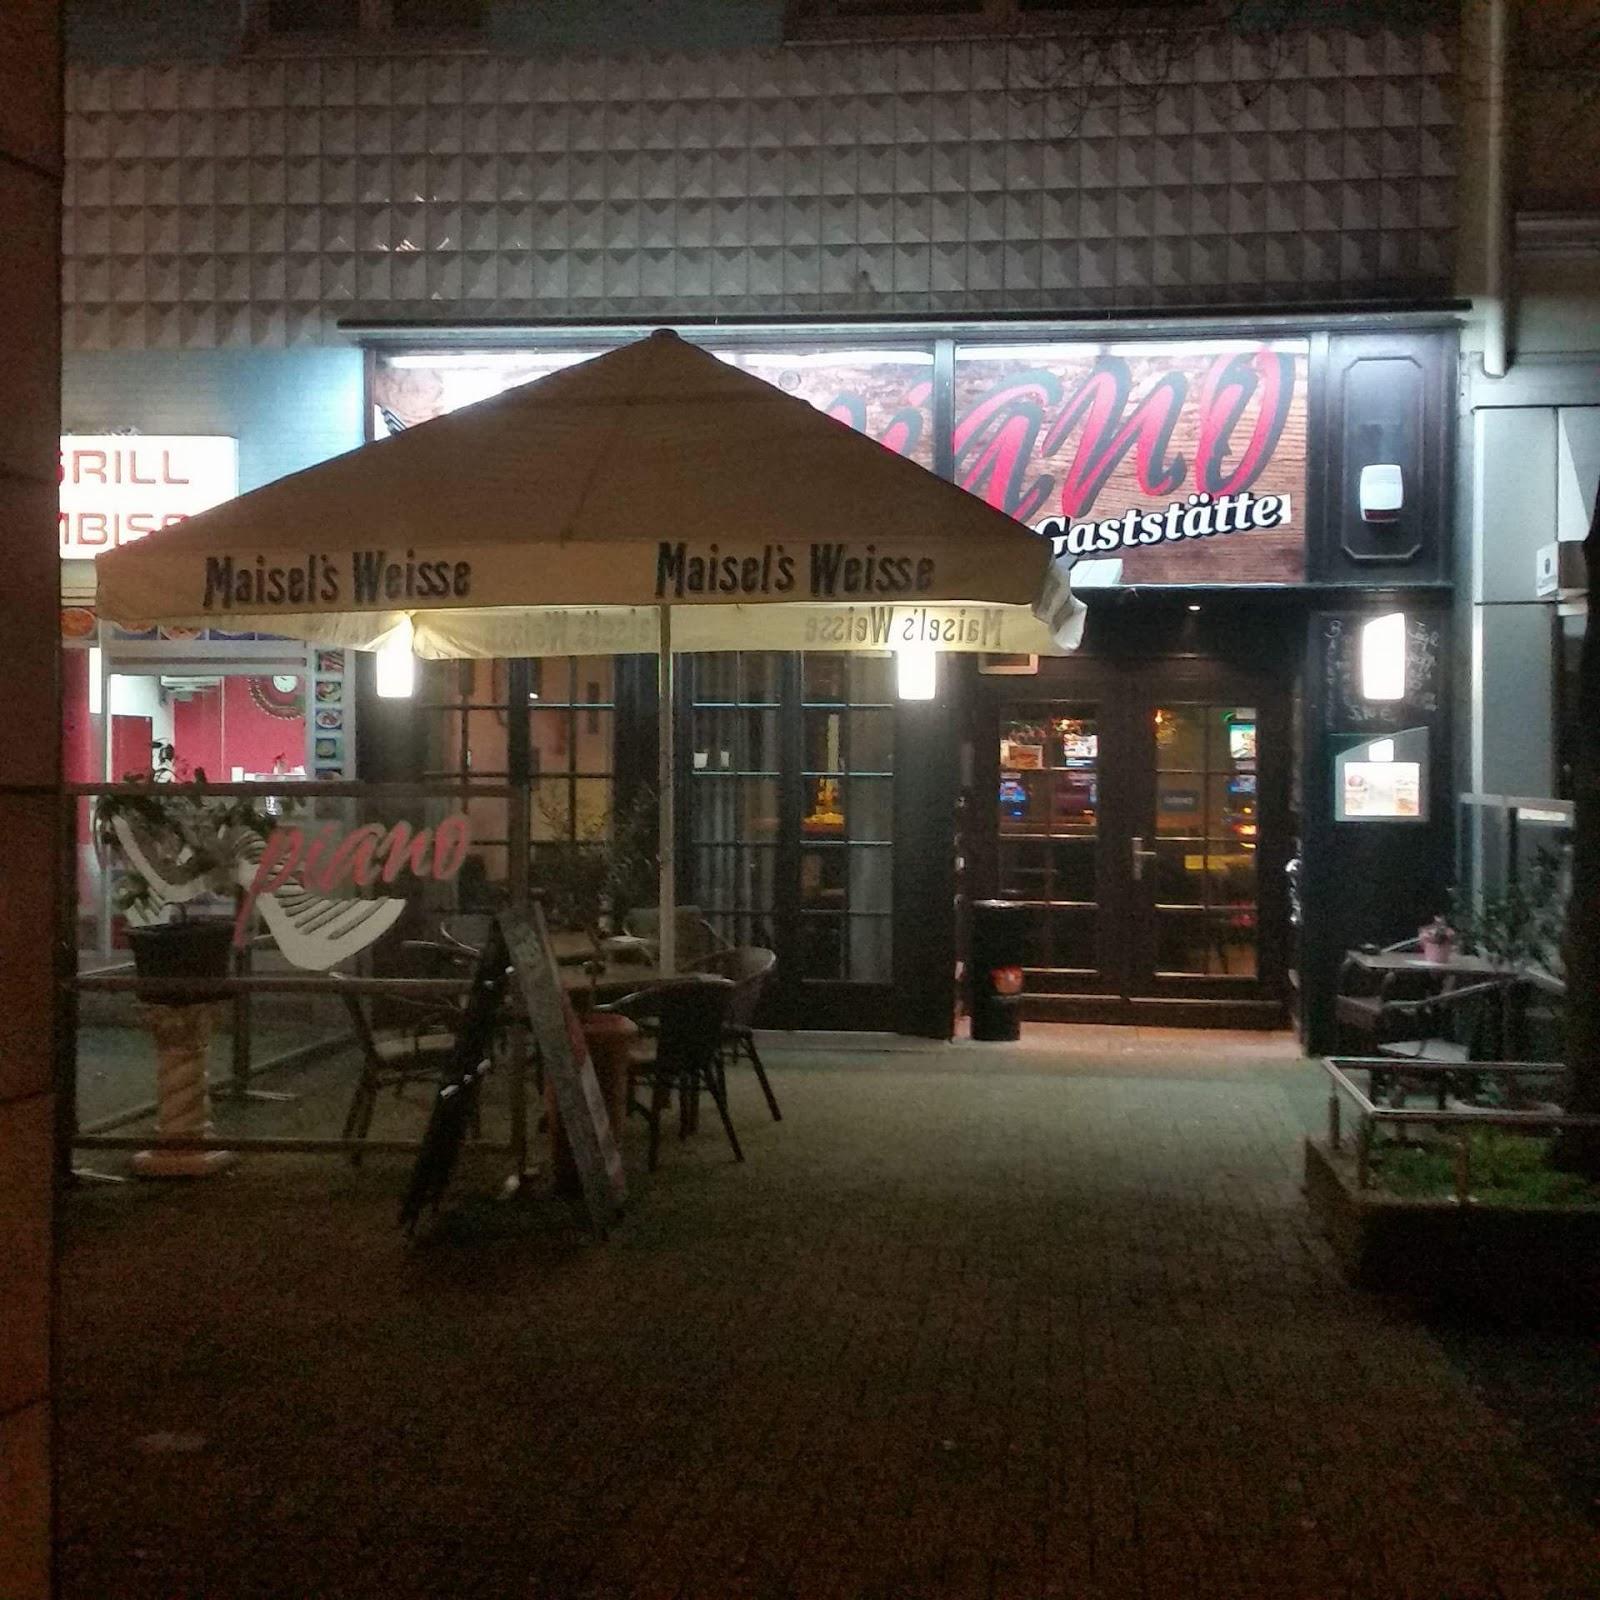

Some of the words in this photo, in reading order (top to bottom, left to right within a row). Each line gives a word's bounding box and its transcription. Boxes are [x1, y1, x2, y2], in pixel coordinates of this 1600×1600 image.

[56, 449, 190, 485] RILL
[203, 554, 339, 609] Maisel's
[352, 549, 471, 604] Weisse
[655, 541, 795, 599] Maisel's
[810, 544, 935, 596] Weisse
[232, 815, 470, 950] piano
